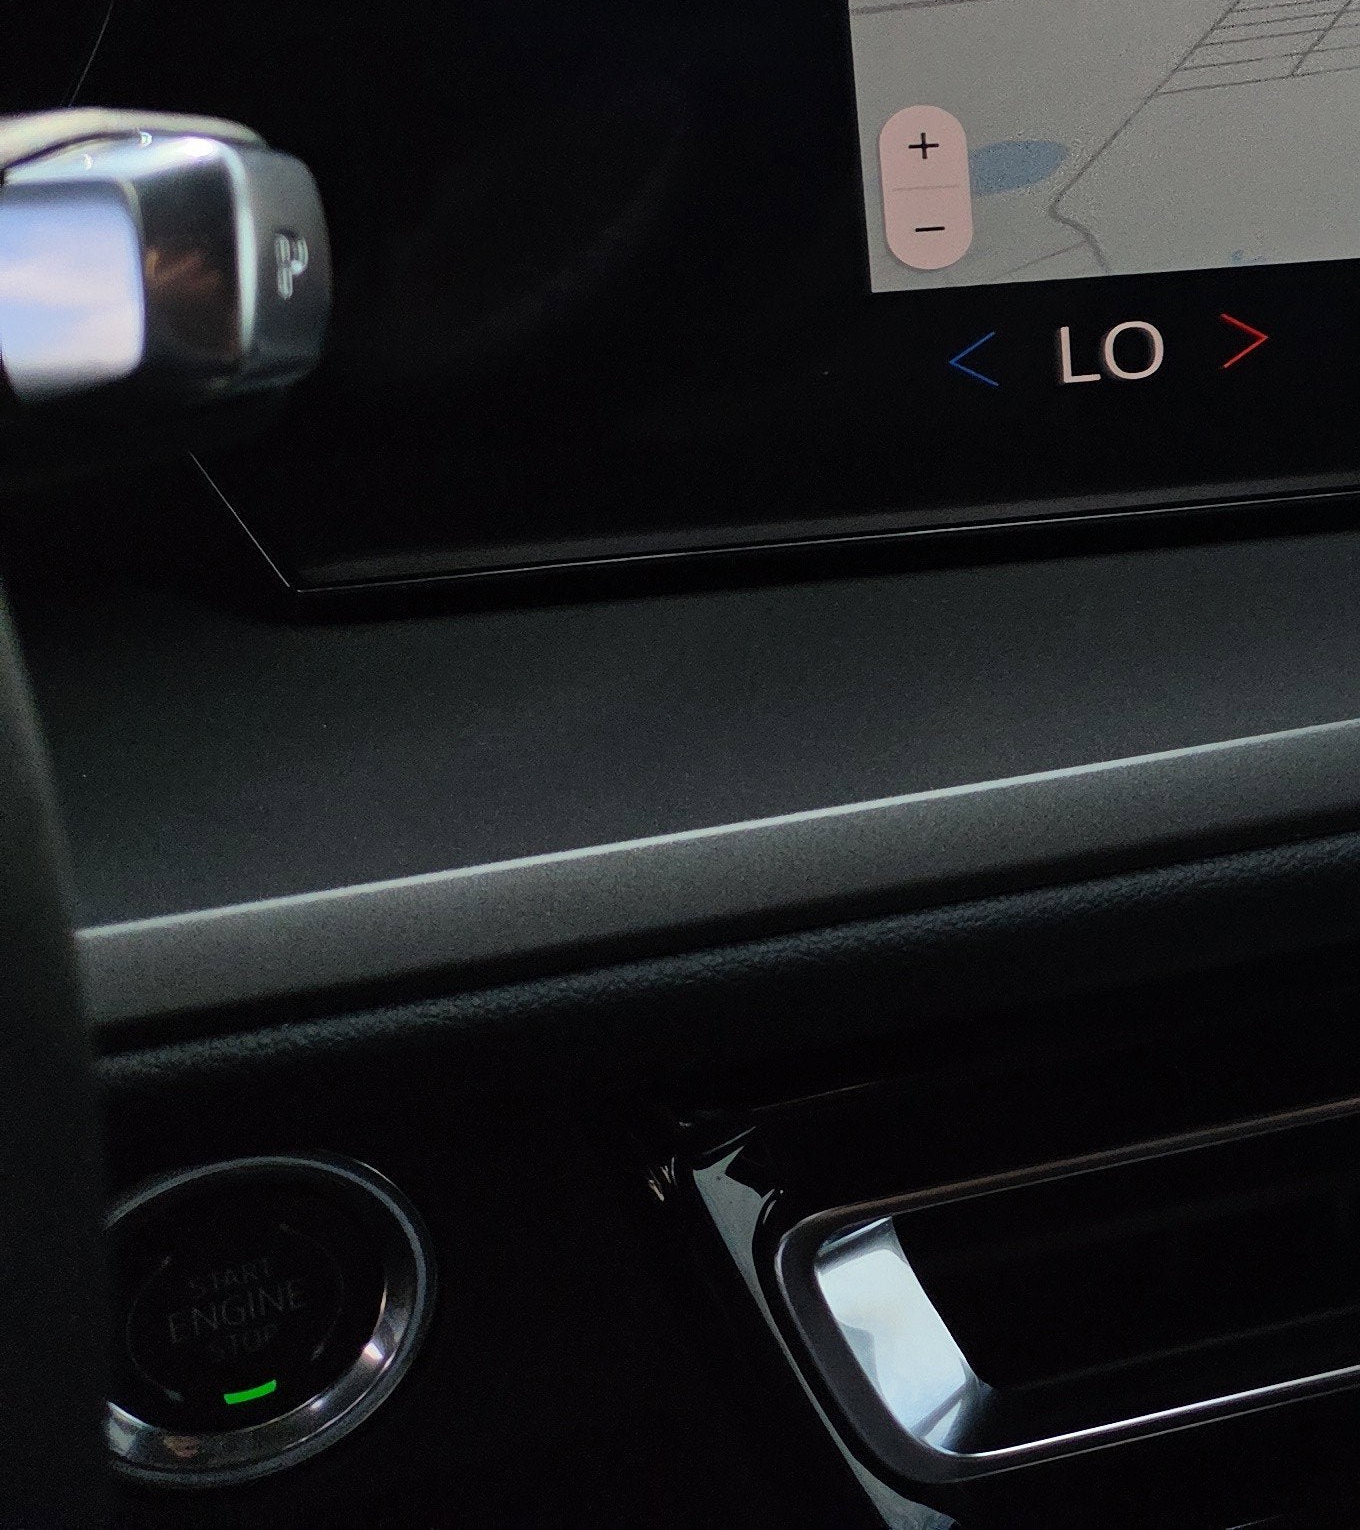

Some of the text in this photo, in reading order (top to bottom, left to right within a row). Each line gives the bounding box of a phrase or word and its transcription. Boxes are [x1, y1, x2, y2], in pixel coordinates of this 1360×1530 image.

[1059, 320, 1164, 384] LO
[188, 1255, 273, 1300] START
[165, 1277, 308, 1346] ENGINE
